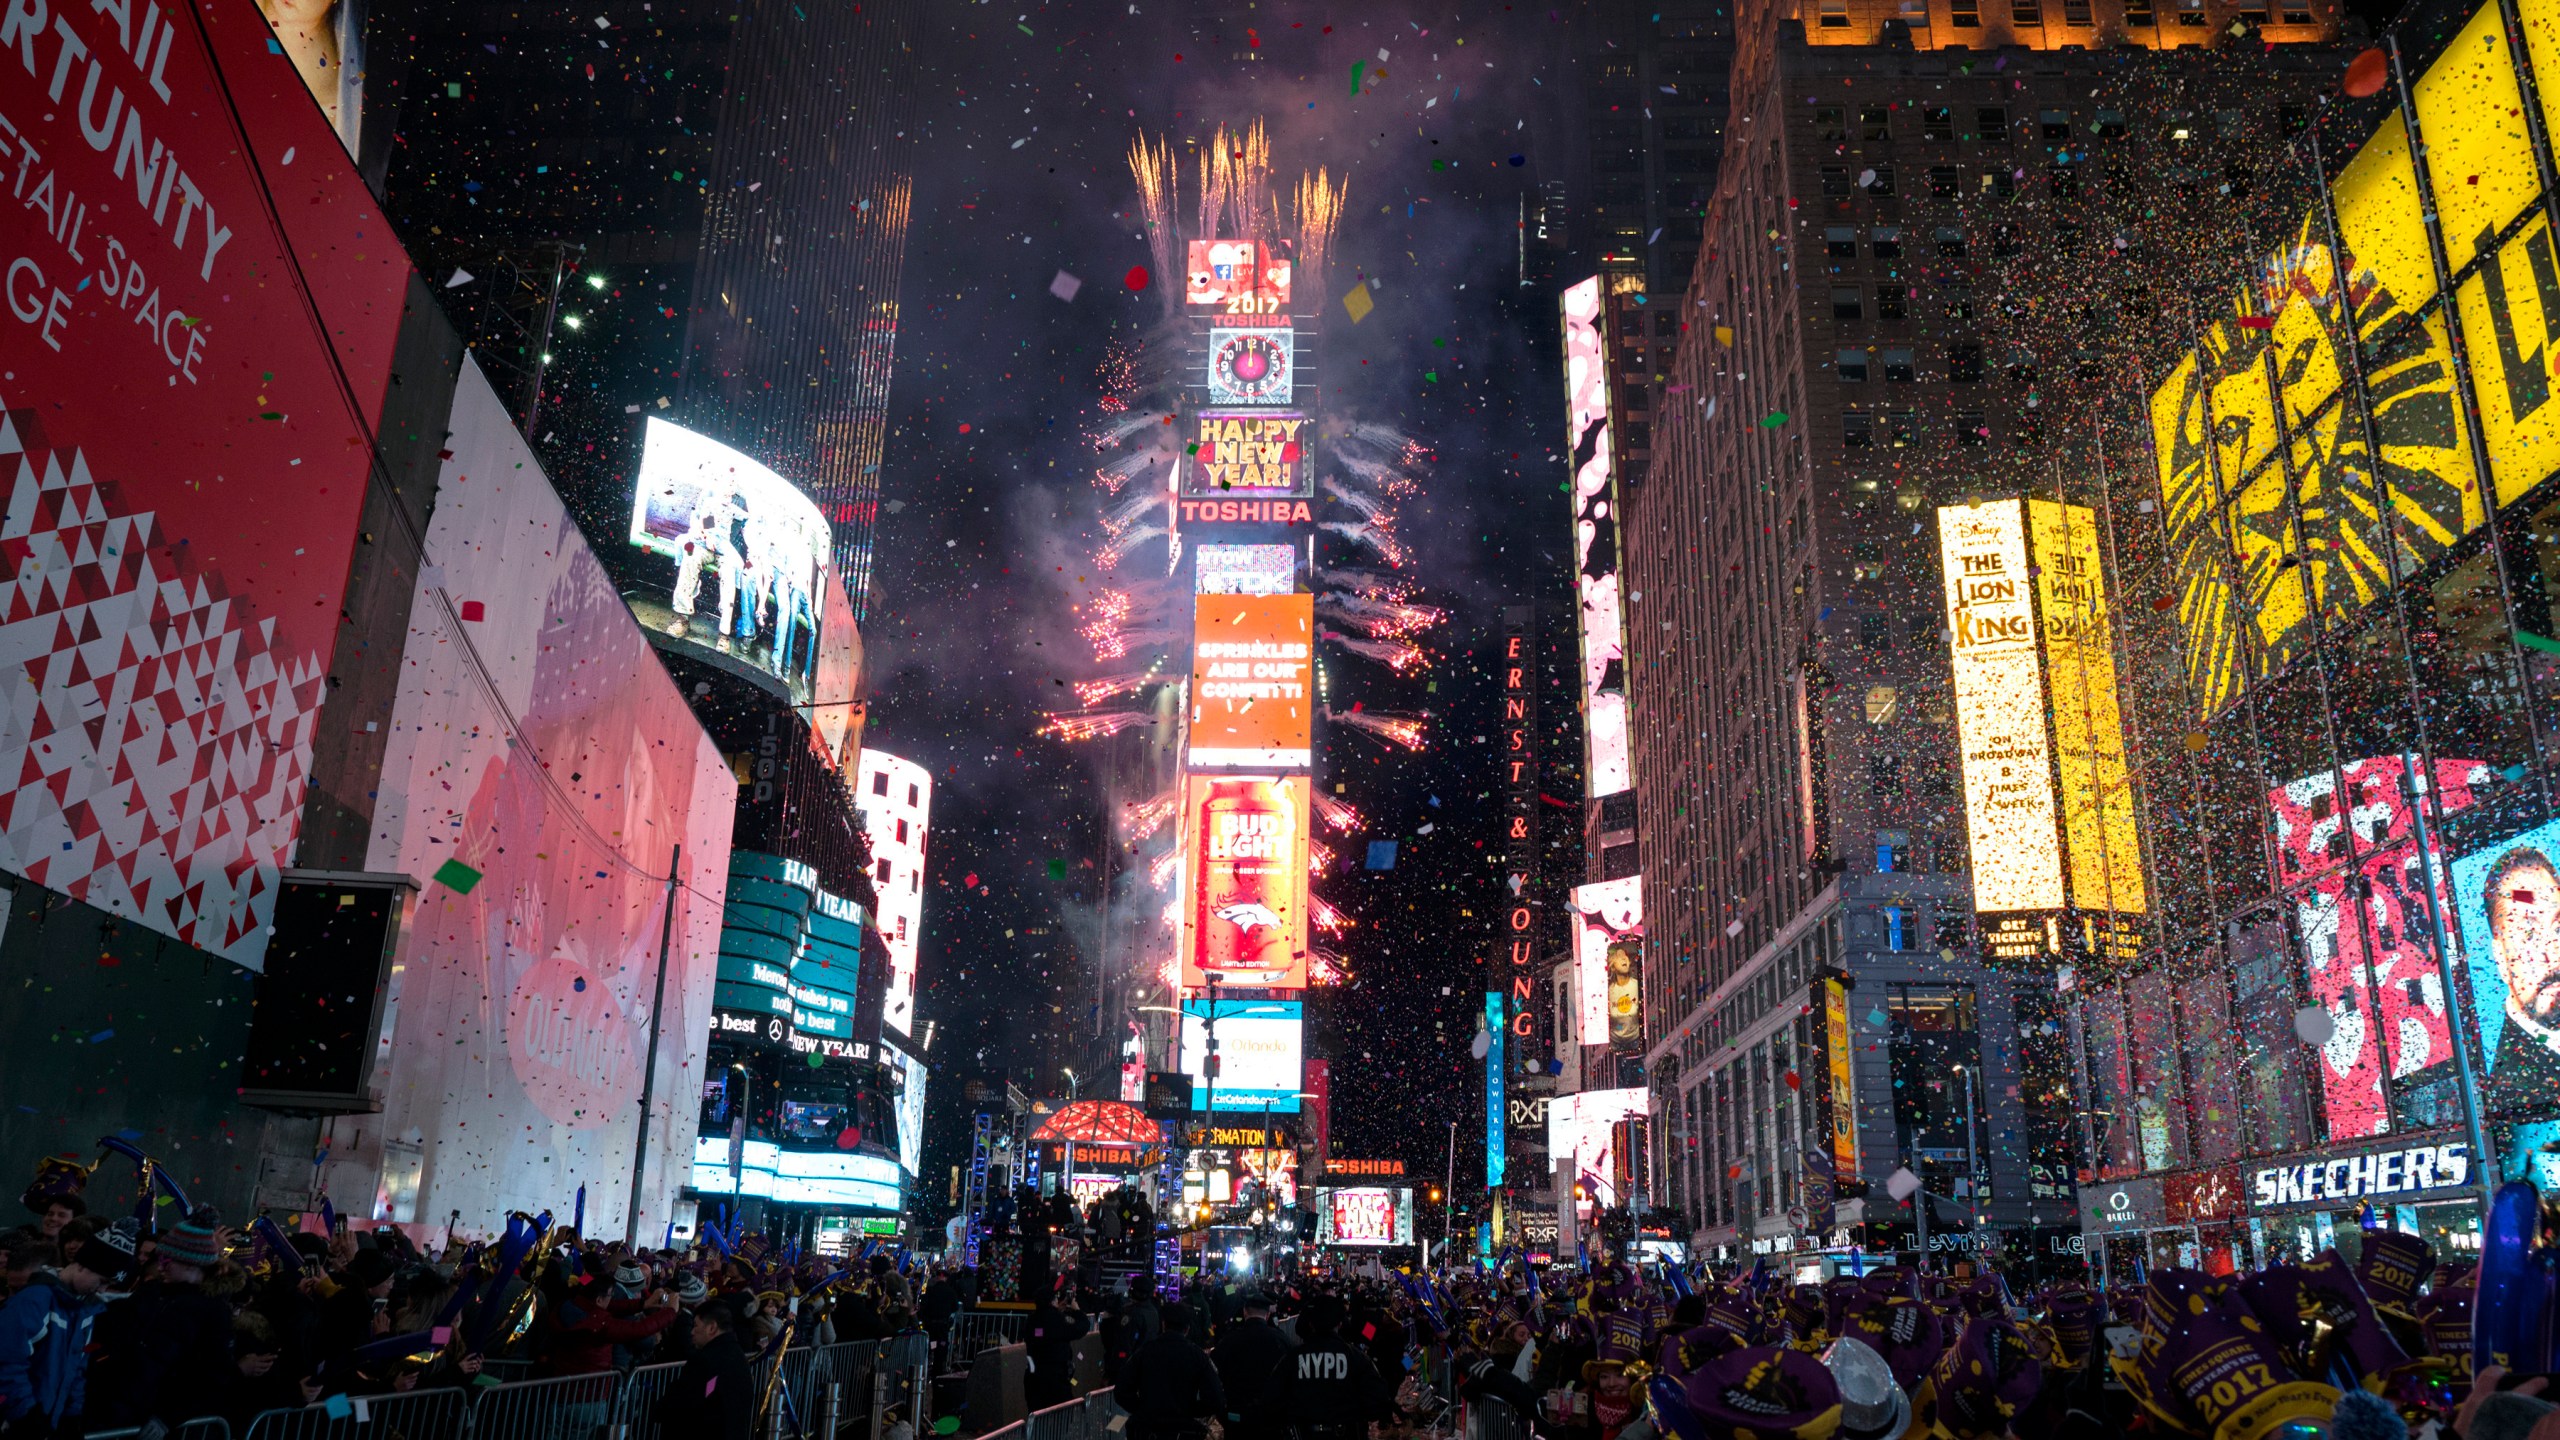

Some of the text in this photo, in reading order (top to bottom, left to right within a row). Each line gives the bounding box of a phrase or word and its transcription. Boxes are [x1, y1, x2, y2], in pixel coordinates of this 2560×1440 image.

[6, 257, 72, 352] GE
[99, 235, 206, 385] SPACE
[1227, 296, 1279, 314] 2017
[1213, 314, 1292, 327] TOSHIBA
[1200, 419, 1302, 442] HAPPY
[1214, 441, 1285, 464] NEW
[1204, 463, 1291, 487] YEAR!
[1181, 501, 1312, 522] TOSHIBA
[1960, 553, 2003, 572] THE
[1956, 578, 2016, 608] LION
[1955, 612, 2029, 649] KING
[1198, 643, 1307, 658] SPRINKLES
[1207, 662, 1297, 678] ARE OUR
[1201, 682, 1302, 698] CONFETTI
[1508, 637, 1525, 783] ERNST
[754, 714, 778, 802] 1500
[1969, 748, 2042, 761] BROADWAY
[1988, 783, 2027, 793] TIMES
[1220, 814, 1279, 836] BUD
[1510, 817, 1528, 838] &
[2001, 919, 2027, 931] GET
[1987, 931, 2043, 944] TICKETS
[1995, 944, 2036, 957] HERE!
[830, 997, 848, 1012] you
[721, 1013, 757, 1033] best
[807, 1011, 836, 1032] best
[525, 992, 623, 1093] OLD NAVY
[821, 1040, 869, 1059] YEAR!
[1231, 1038, 1287, 1053] Orlando
[1325, 1159, 1404, 1175] TOSHIBA
[2254, 1142, 2469, 1207] SKECHERS
[1336, 1195, 1390, 1210] HAPPY
[1345, 1209, 1385, 1224] NEW
[2368, 1260, 2416, 1292] 2017
[1611, 1330, 1641, 1352] 2017
[2207, 1343, 2255, 1367] SQUARE
[1298, 1352, 1348, 1380] NYPD
[2194, 1363, 2276, 1420] 2017
